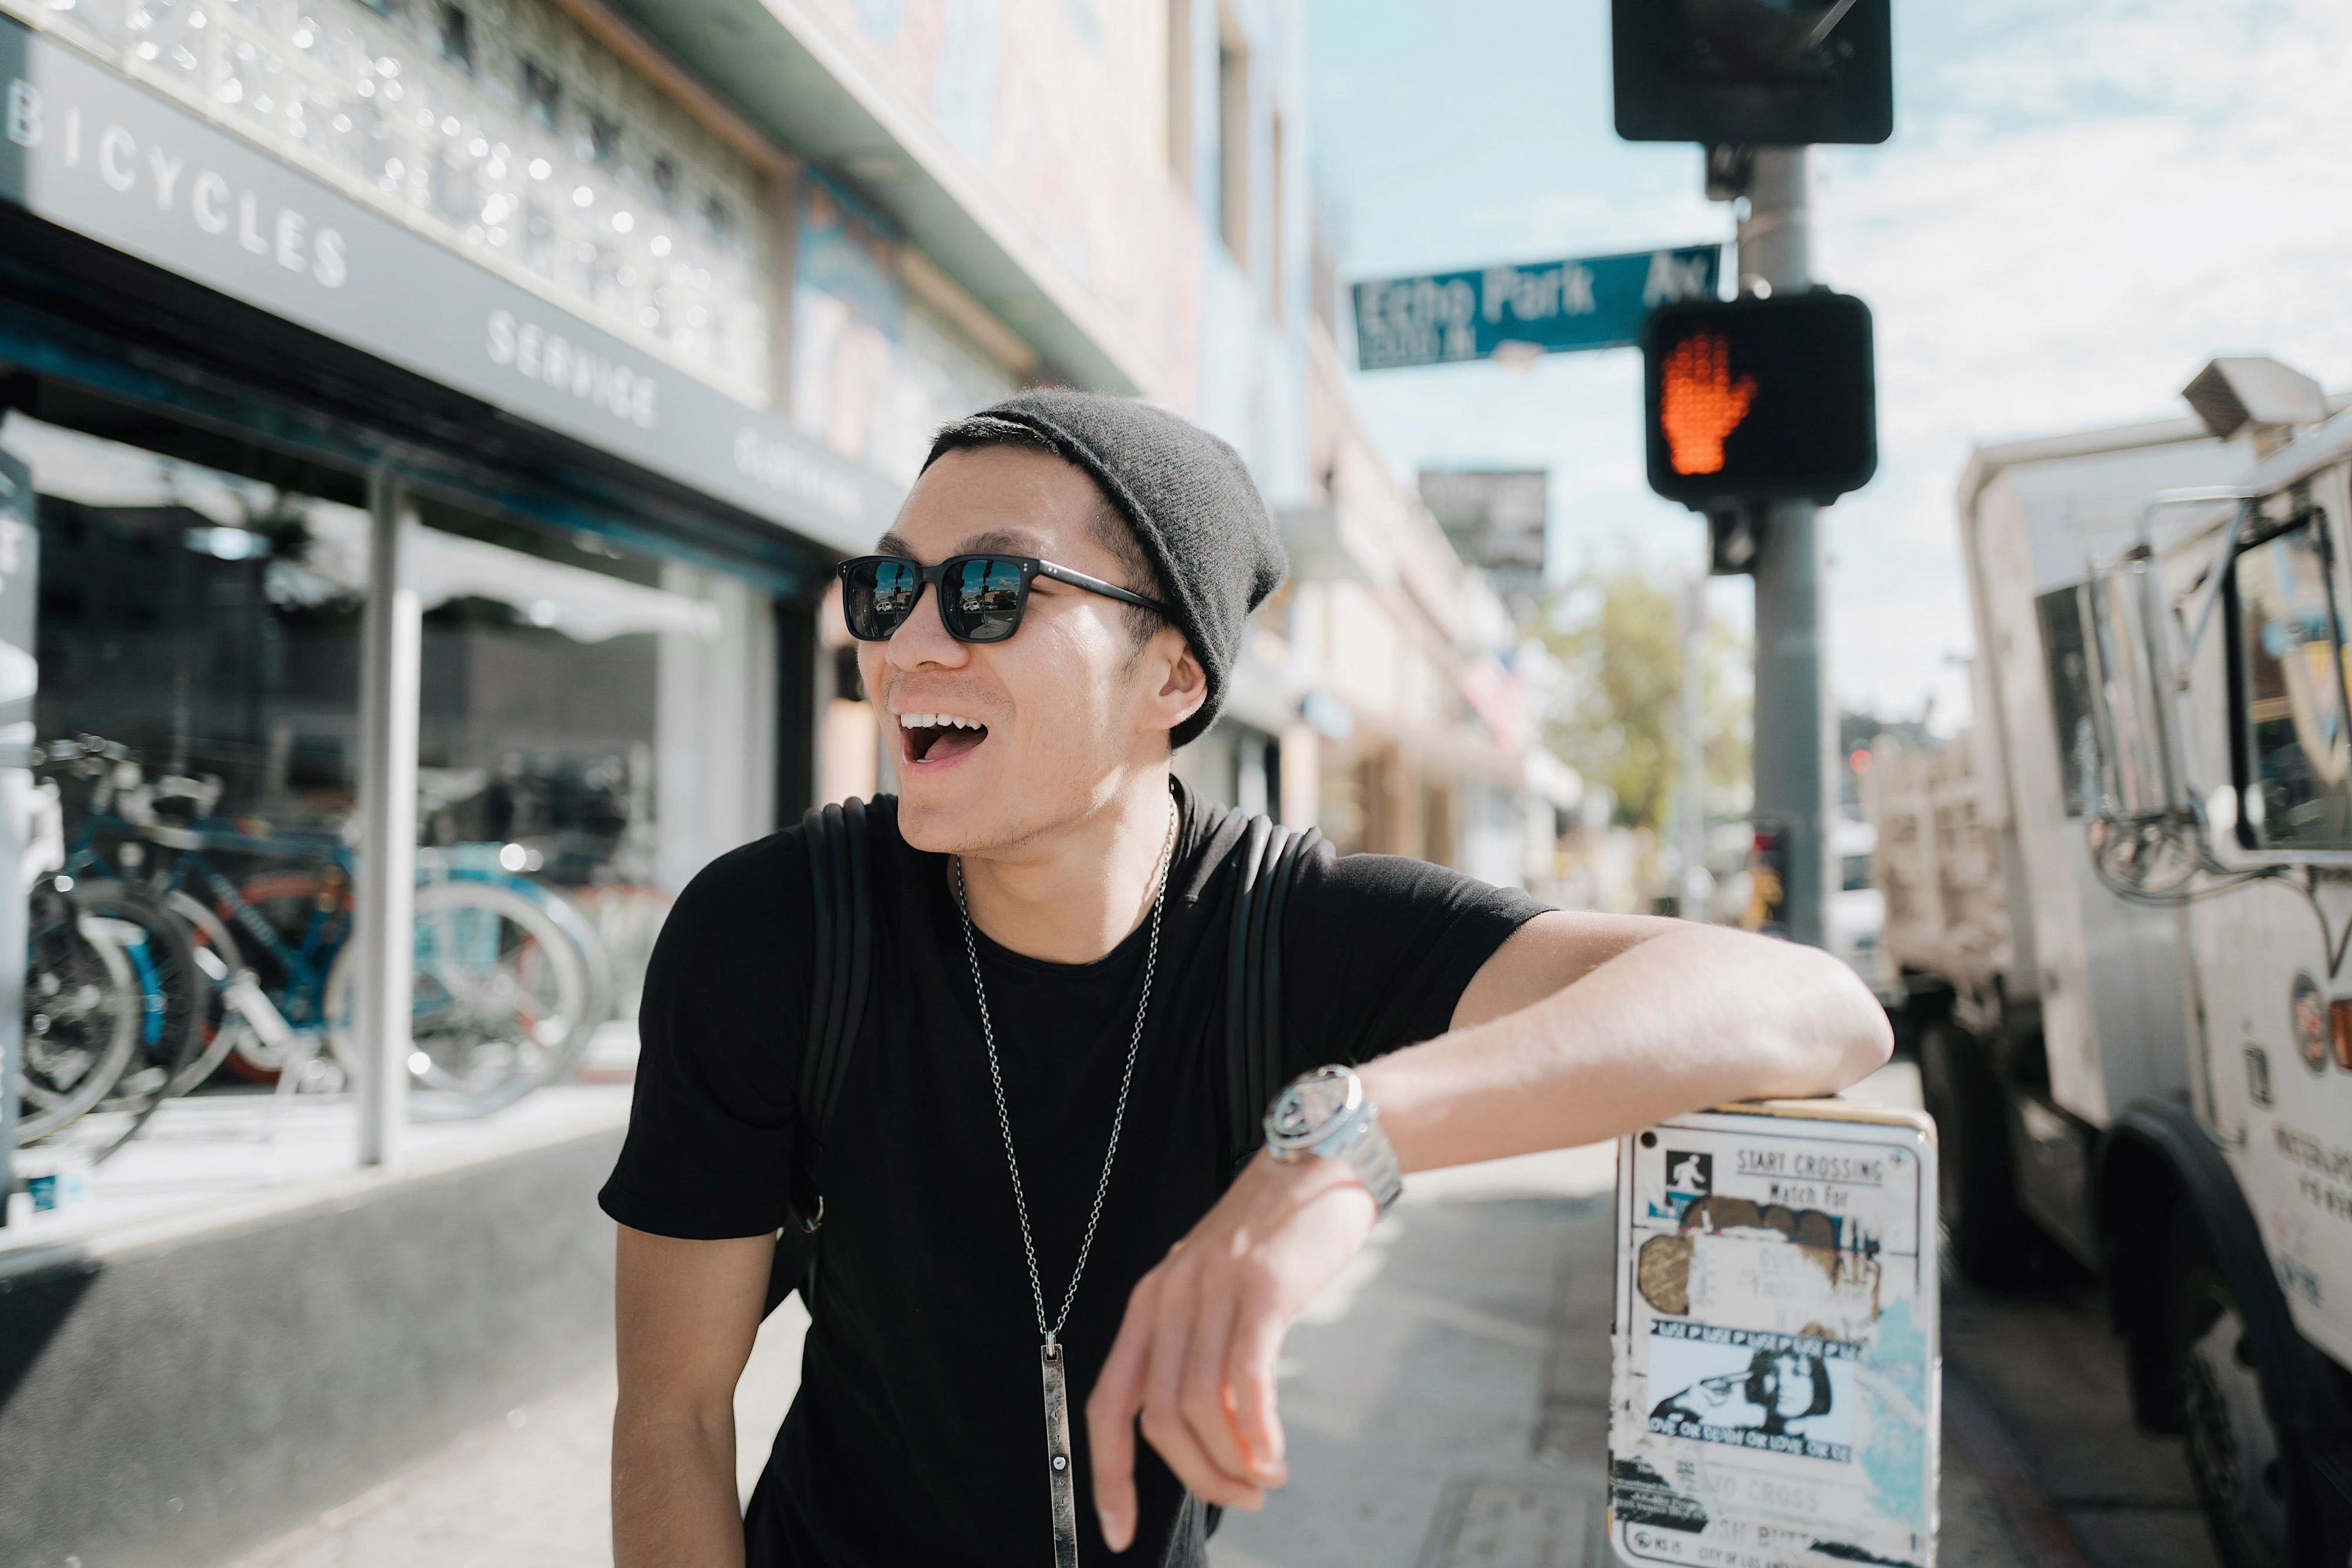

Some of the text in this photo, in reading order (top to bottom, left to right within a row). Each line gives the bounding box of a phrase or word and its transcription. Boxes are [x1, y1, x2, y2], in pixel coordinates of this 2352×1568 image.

[6, 76, 348, 289] BICYCLES
[1481, 259, 1596, 324] Park
[1738, 1149, 1883, 1181] START CROSSING
[1769, 1181, 1815, 1204] Watch
